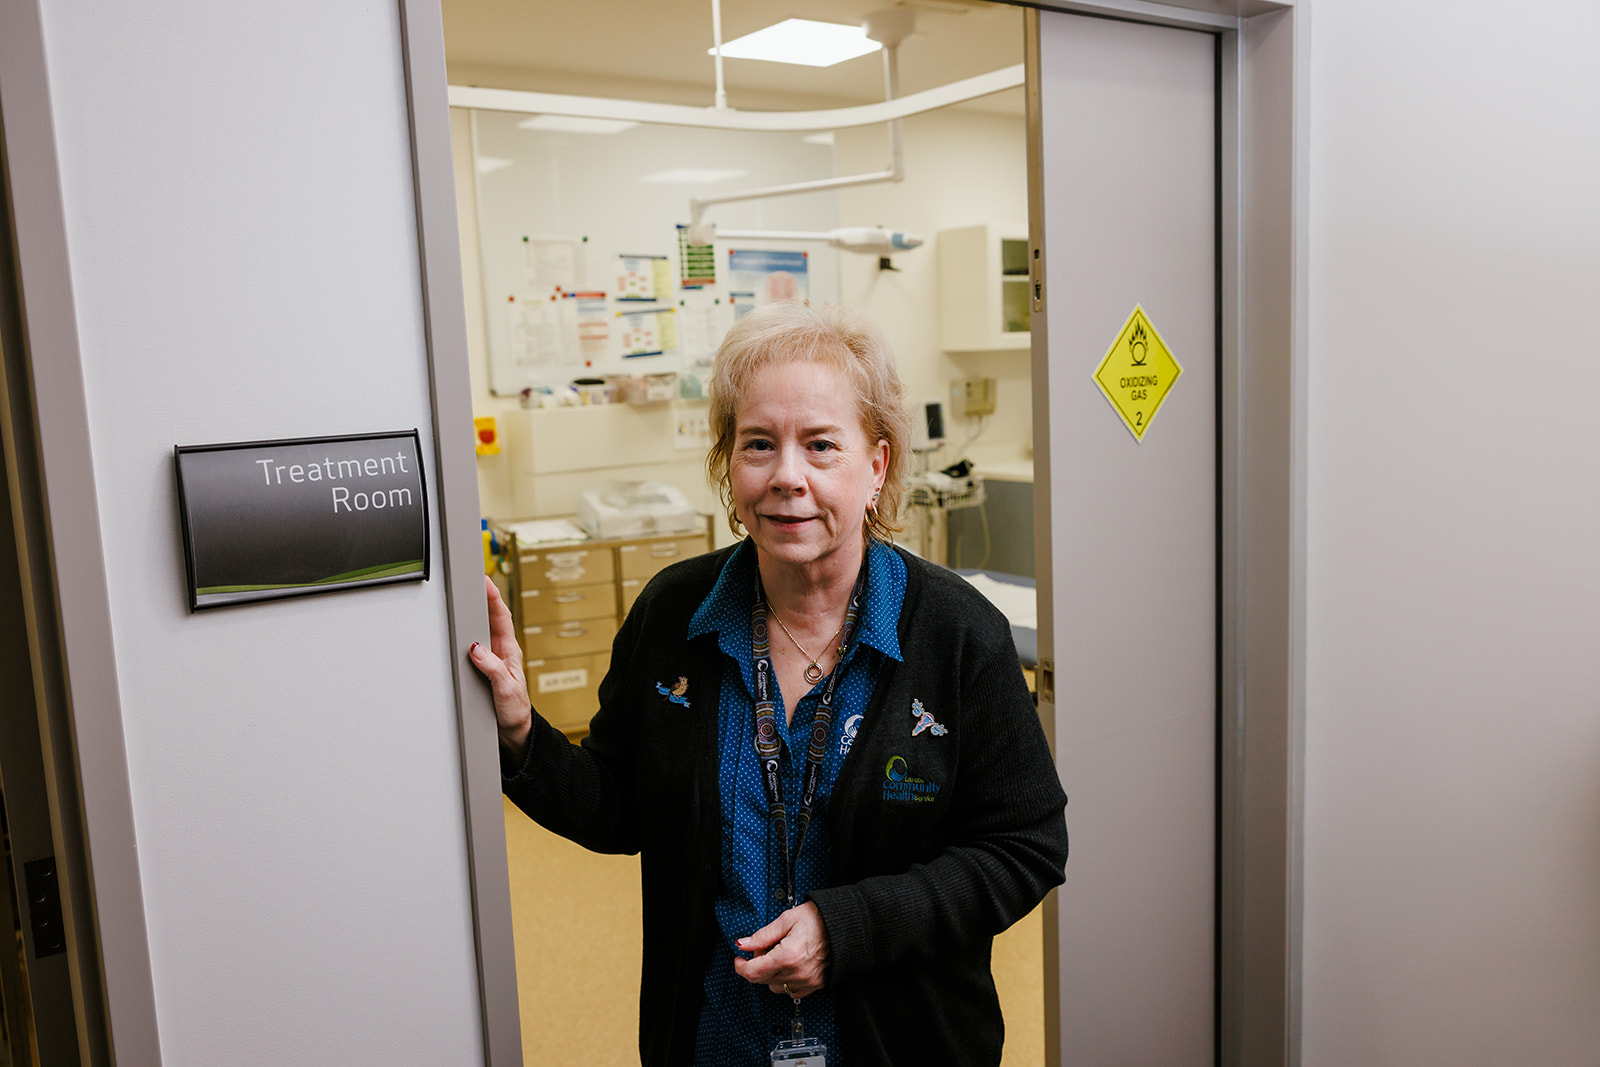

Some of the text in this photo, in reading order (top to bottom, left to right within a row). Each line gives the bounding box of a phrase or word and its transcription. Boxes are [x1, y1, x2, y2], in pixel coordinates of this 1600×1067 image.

[1119, 375, 1158, 388] OXIDIZING
[1131, 389, 1147, 401] GAS
[1135, 411, 1143, 426] 2
[256, 451, 409, 486] Treatment
[331, 486, 412, 513] Room
[882, 779, 942, 795] Community
[883, 789, 915, 801] Health
